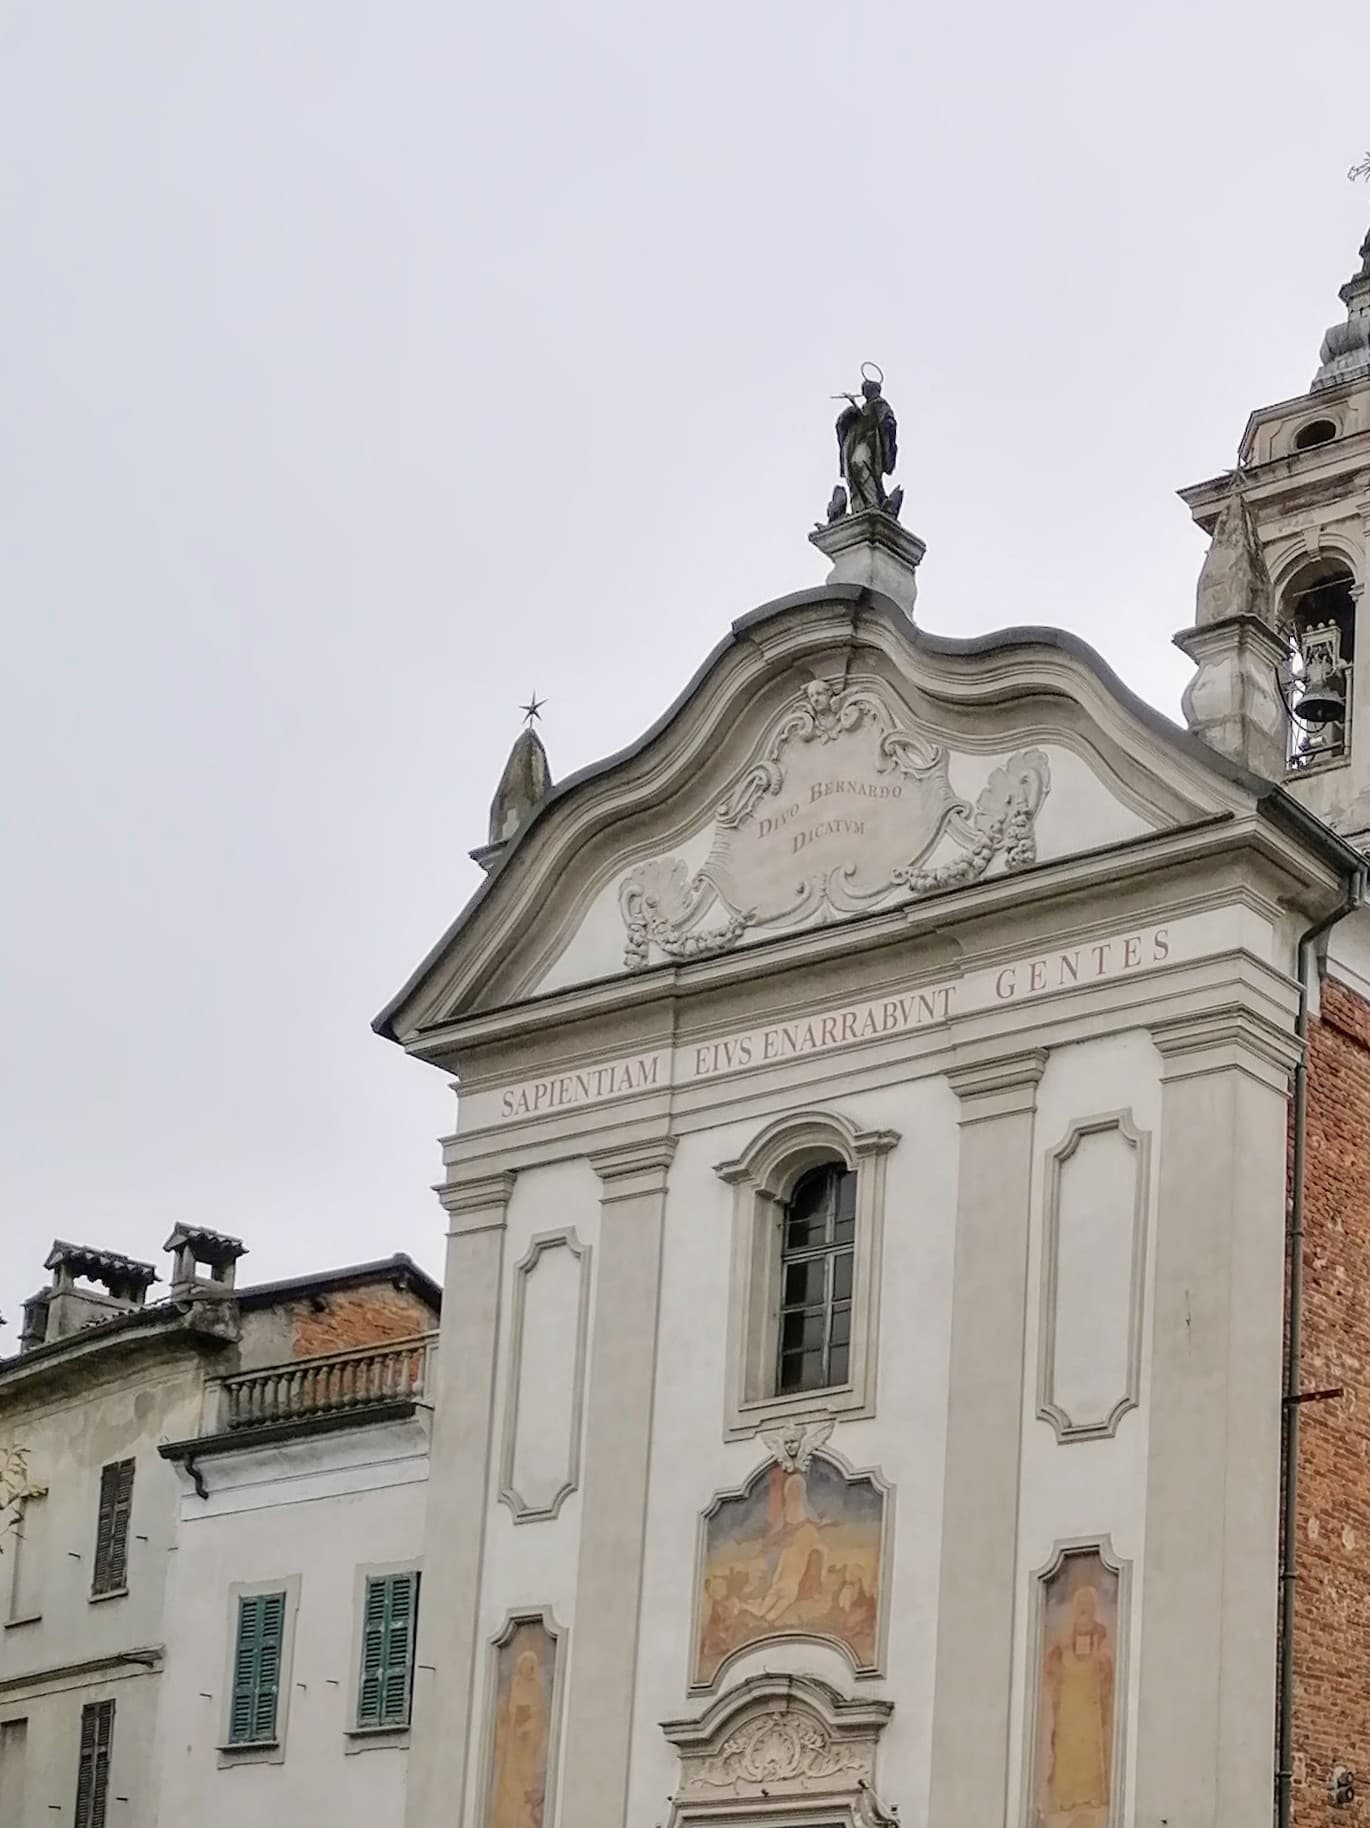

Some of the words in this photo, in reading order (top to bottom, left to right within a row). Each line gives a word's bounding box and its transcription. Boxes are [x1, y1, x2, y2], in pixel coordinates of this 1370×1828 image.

[758, 803, 799, 839] DIVO
[809, 780, 903, 803] BERNARDO
[501, 1056, 659, 1118] SAPIENTIAM
[694, 1036, 751, 1076] EIVS
[762, 985, 957, 1061] ENARRABVNT
[995, 930, 1170, 999] GENTES
